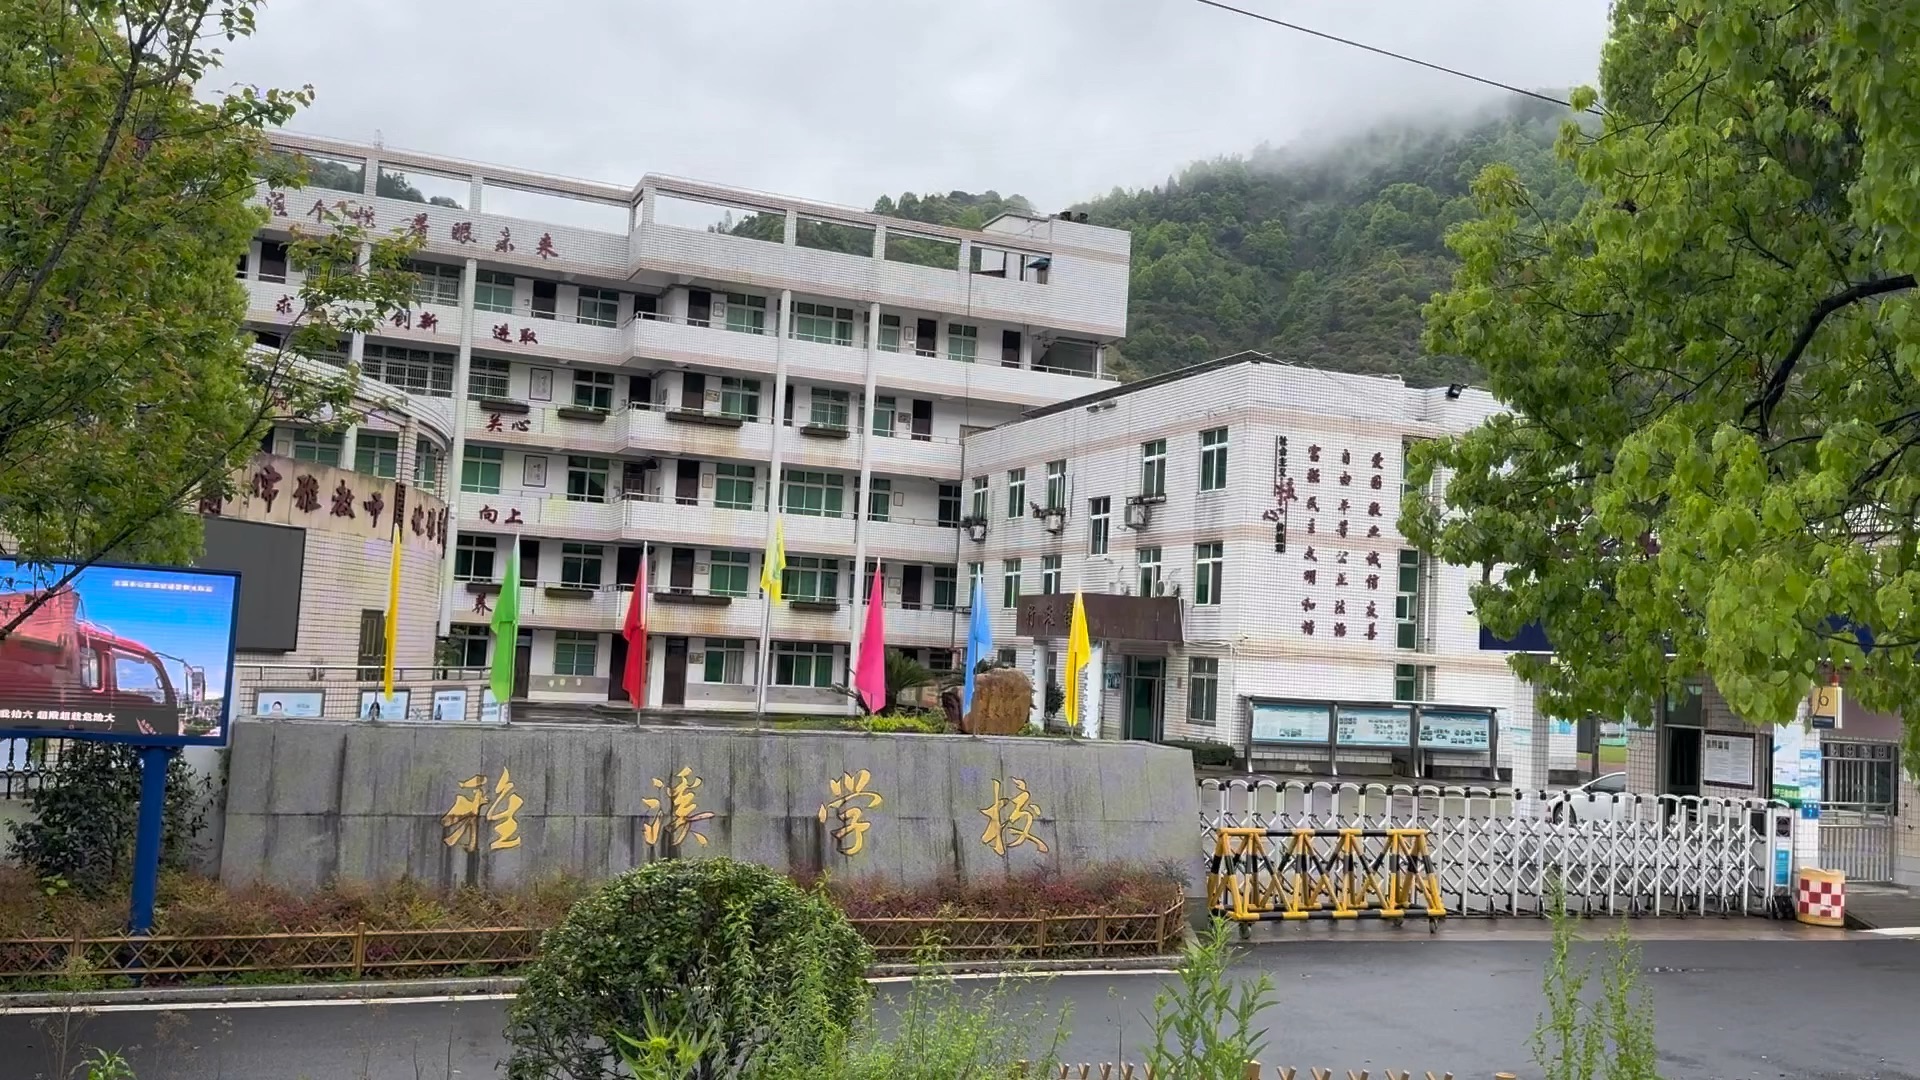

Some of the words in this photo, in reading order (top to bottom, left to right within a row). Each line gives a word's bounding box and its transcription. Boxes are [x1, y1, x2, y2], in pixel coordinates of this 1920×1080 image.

[390, 308, 439, 334] 创新
[492, 323, 538, 345] 进取
[486, 413, 531, 432] 关心
[479, 504, 523, 524] 向上
[442, 766, 1050, 857] 雅溪学校
